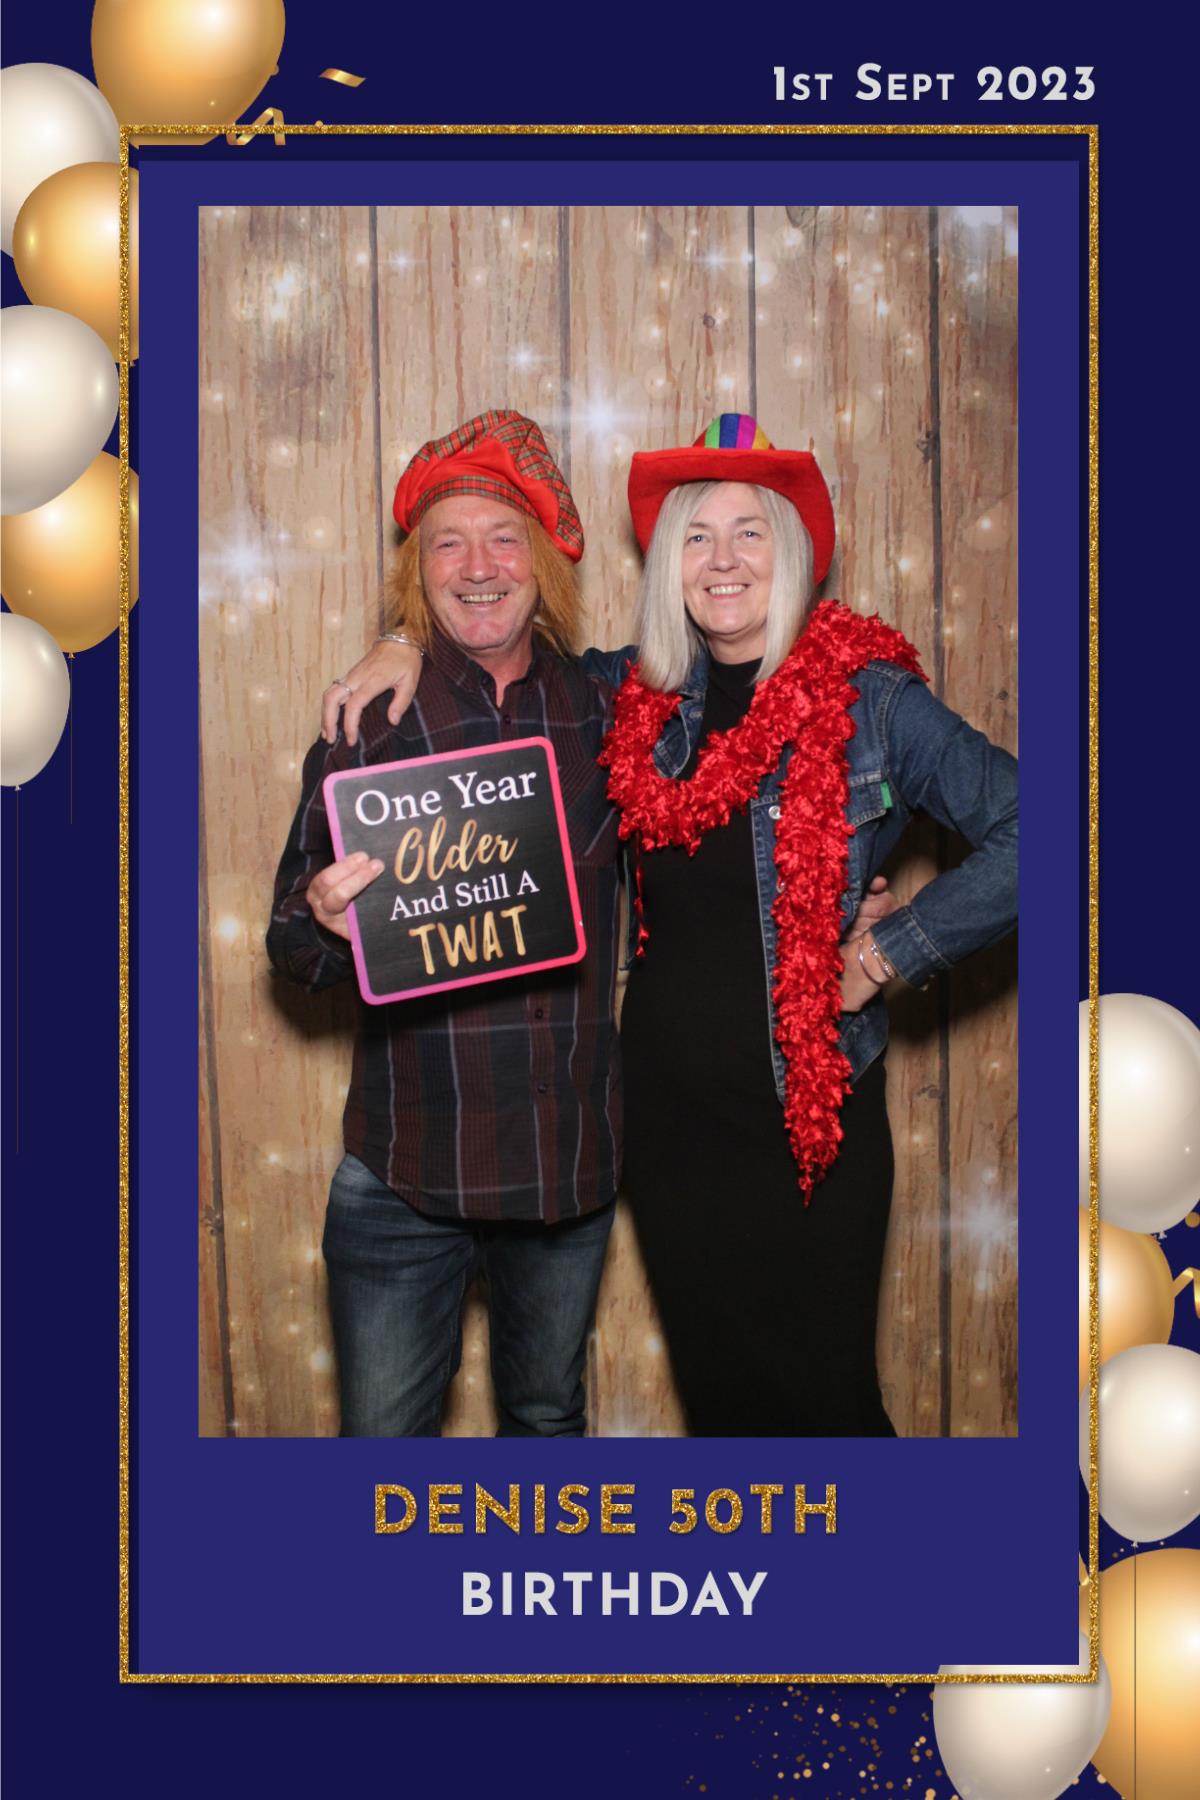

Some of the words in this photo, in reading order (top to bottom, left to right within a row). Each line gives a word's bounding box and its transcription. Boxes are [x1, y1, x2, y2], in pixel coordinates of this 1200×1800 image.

[354, 789, 442, 826] One
[448, 771, 537, 809] Year
[393, 816, 519, 885] Older
[389, 889, 449, 922] And
[455, 875, 511, 908] Still
[516, 869, 541, 896] A
[408, 904, 528, 976] TWAT
